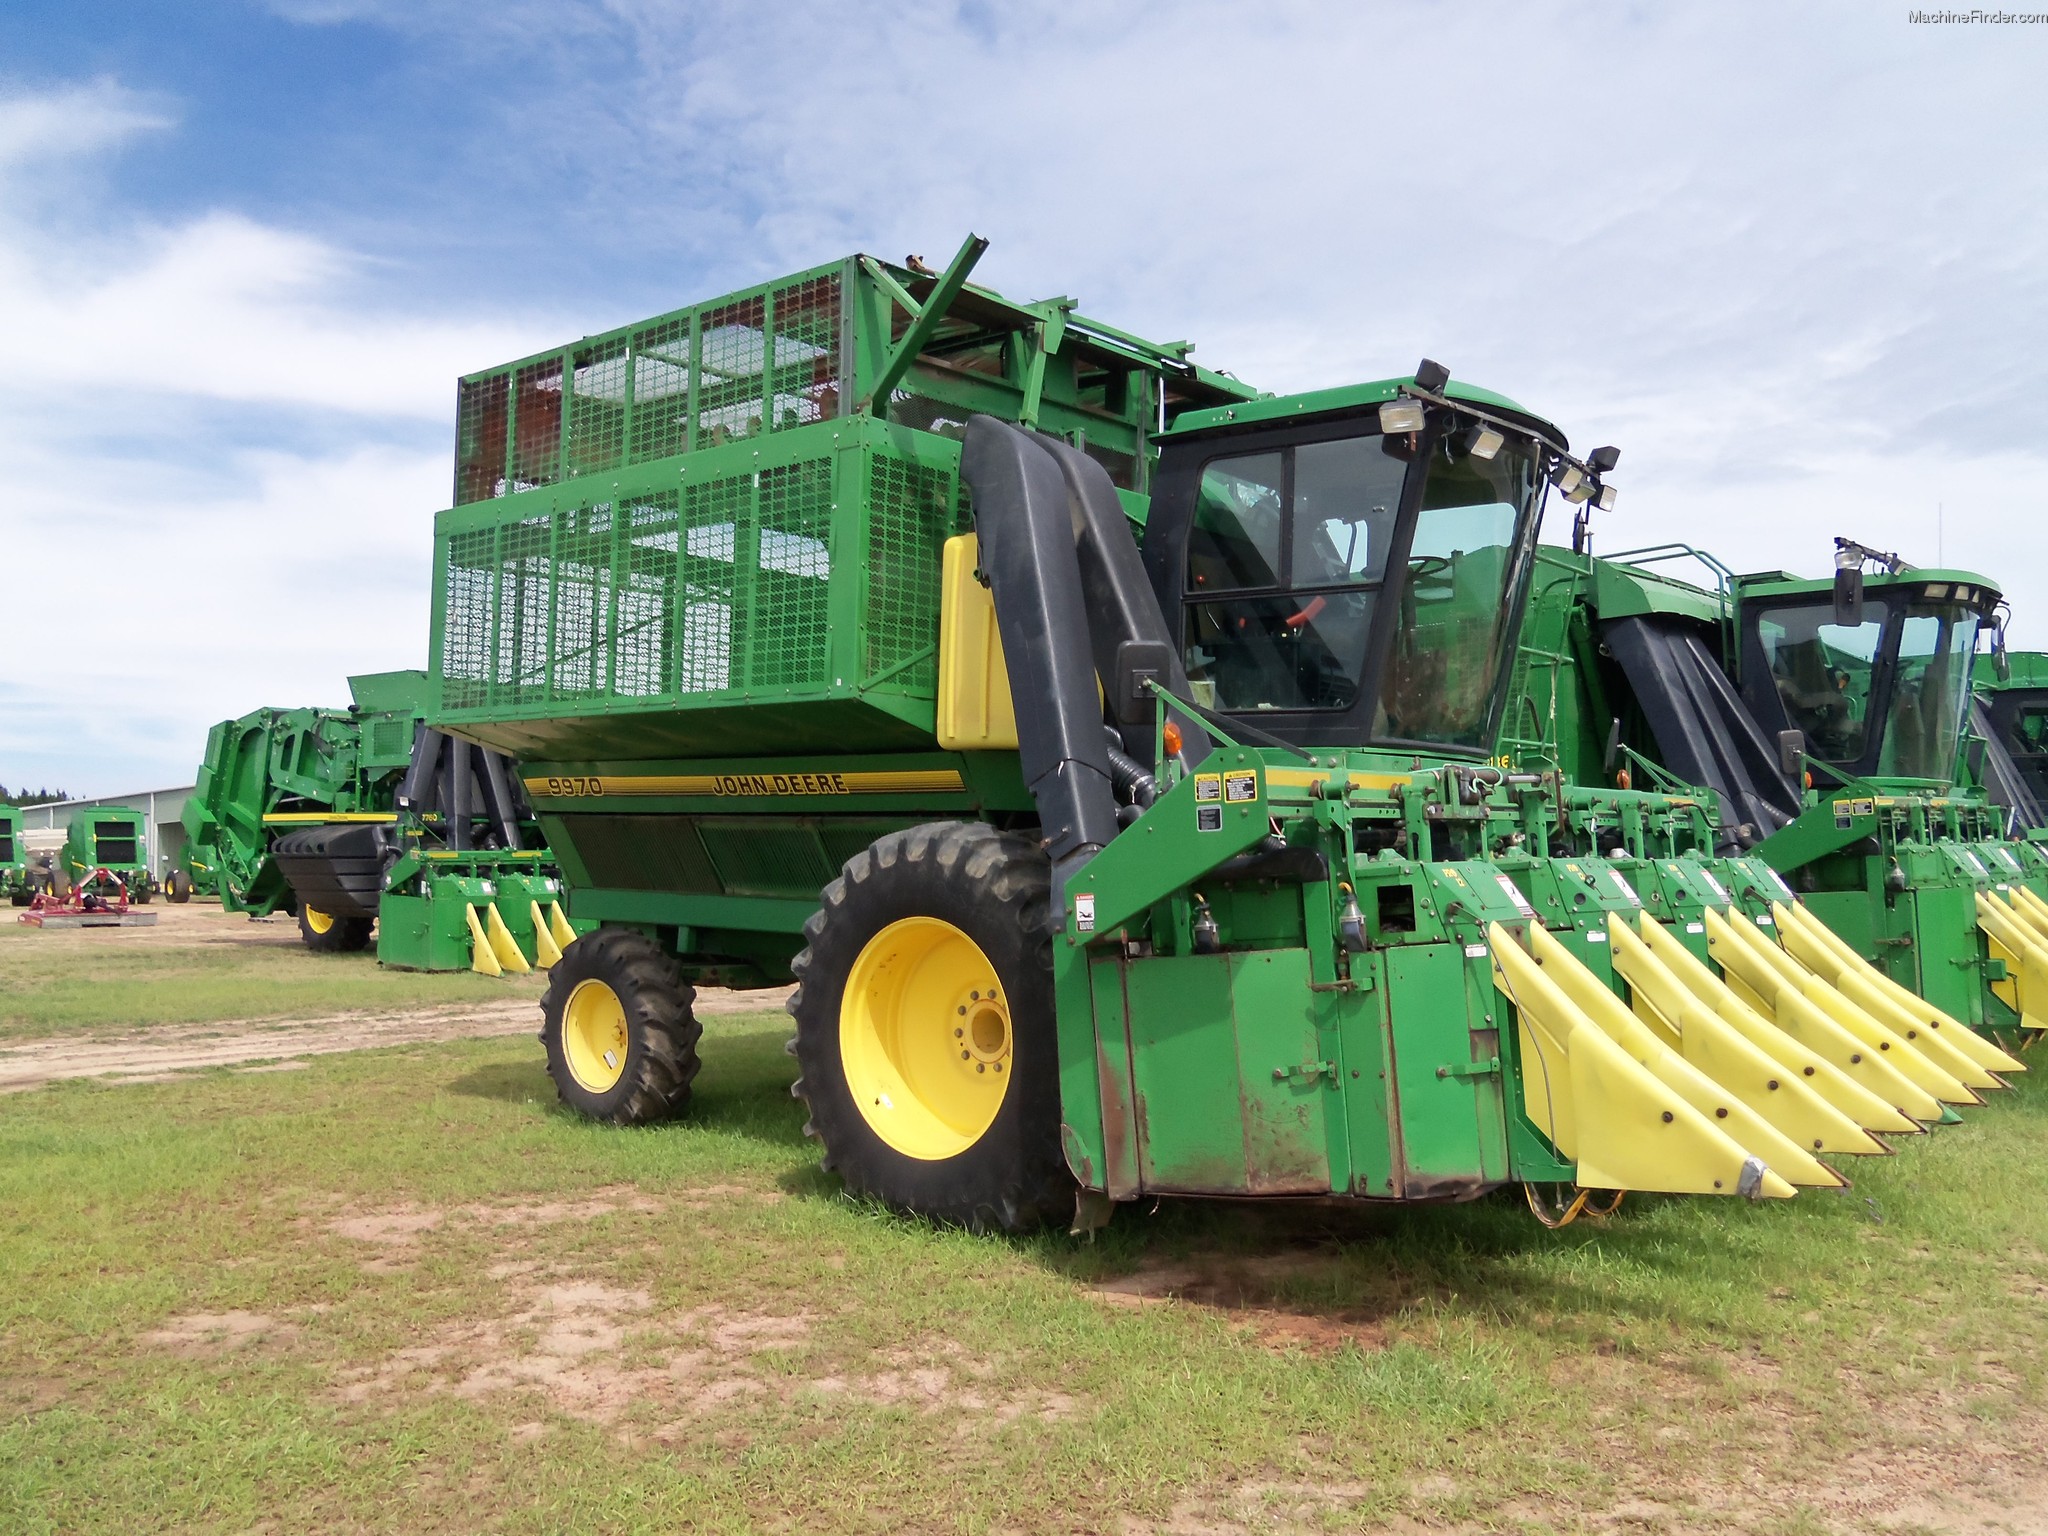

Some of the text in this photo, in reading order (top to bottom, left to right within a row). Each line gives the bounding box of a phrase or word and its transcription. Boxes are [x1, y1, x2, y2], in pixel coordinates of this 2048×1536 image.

[548, 777, 604, 796] 9970
[712, 773, 850, 796] JOHN DEERE
[422, 813, 438, 822] 7760
